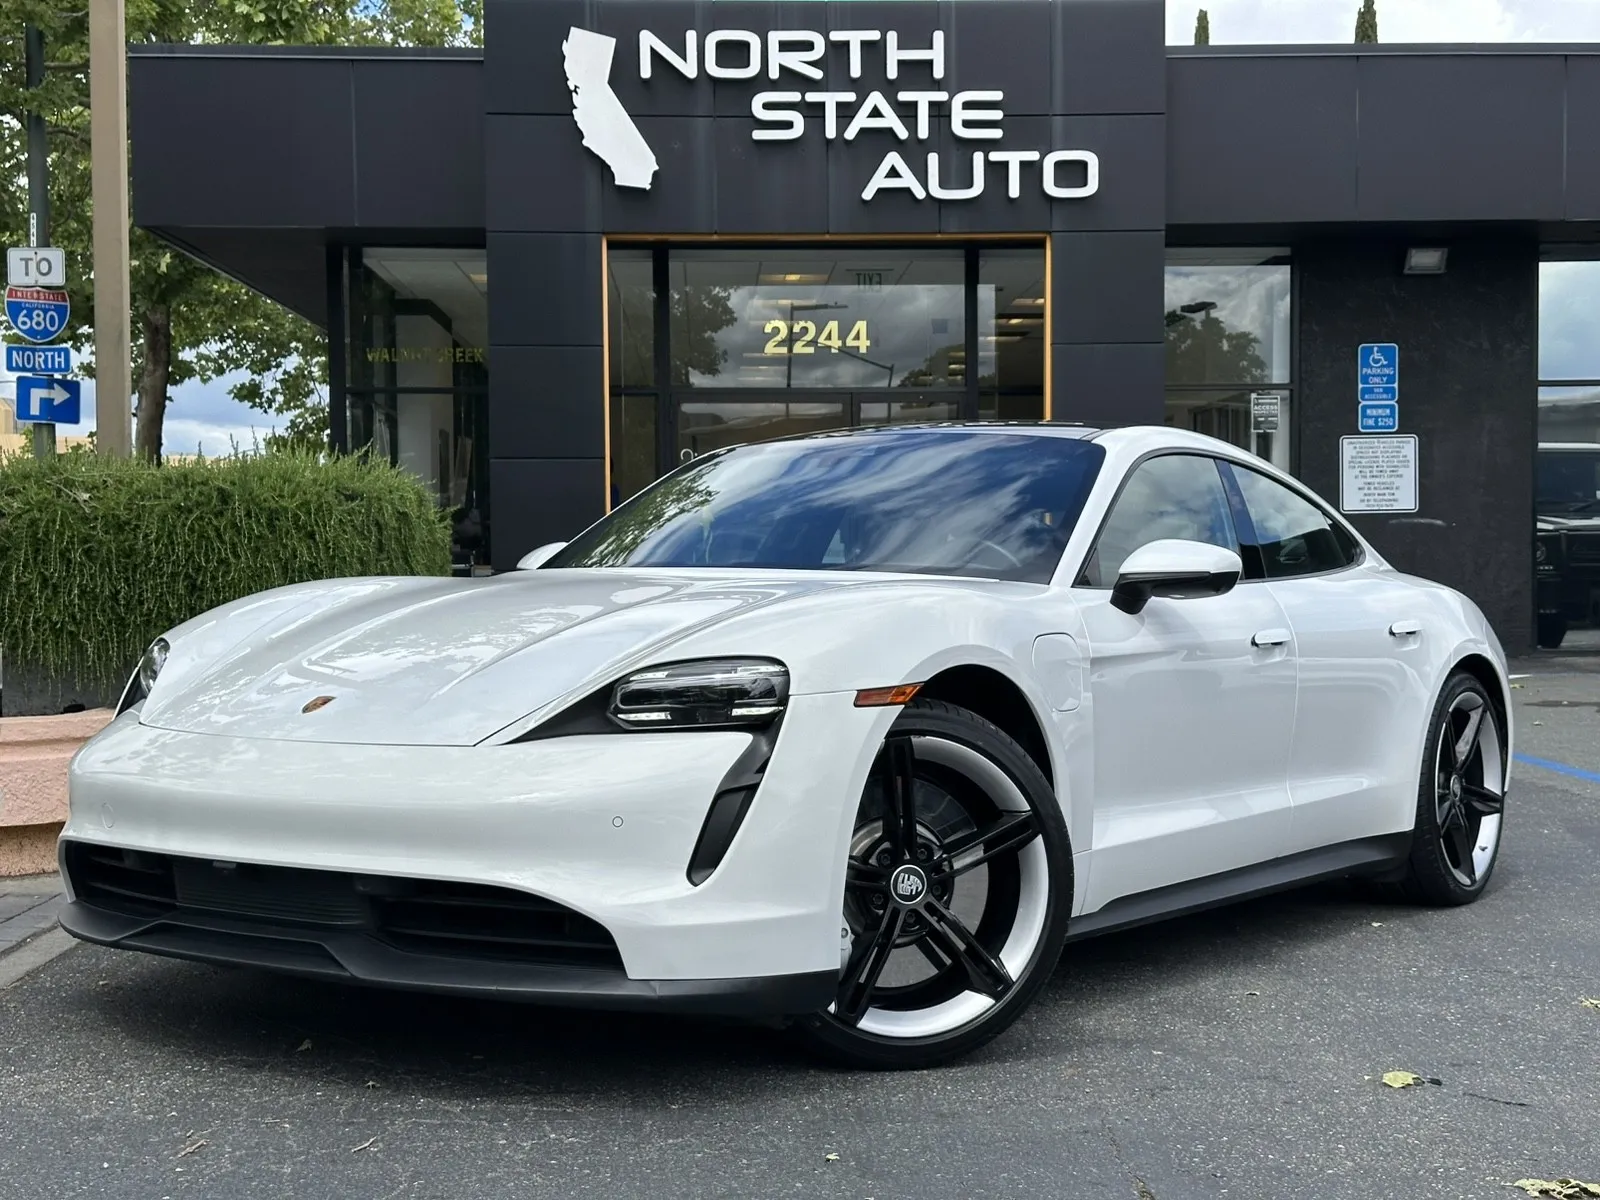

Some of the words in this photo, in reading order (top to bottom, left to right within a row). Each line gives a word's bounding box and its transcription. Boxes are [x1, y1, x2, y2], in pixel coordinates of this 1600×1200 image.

[638, 29, 945, 80] NORTH
[751, 90, 1004, 141] STATE
[861, 150, 1099, 201] AUTO
[19, 257, 53, 277] TO
[11, 290, 63, 301] INTERSTATE
[17, 309, 59, 332] 680
[763, 319, 871, 353] 2244
[12, 350, 65, 369] NORTH
[1362, 367, 1395, 375] PARKING
[1368, 376, 1388, 384] ONLY
[1363, 417, 1376, 426] FINE
[1378, 417, 1394, 426] $250
[1366, 408, 1391, 416] MINIMUM
